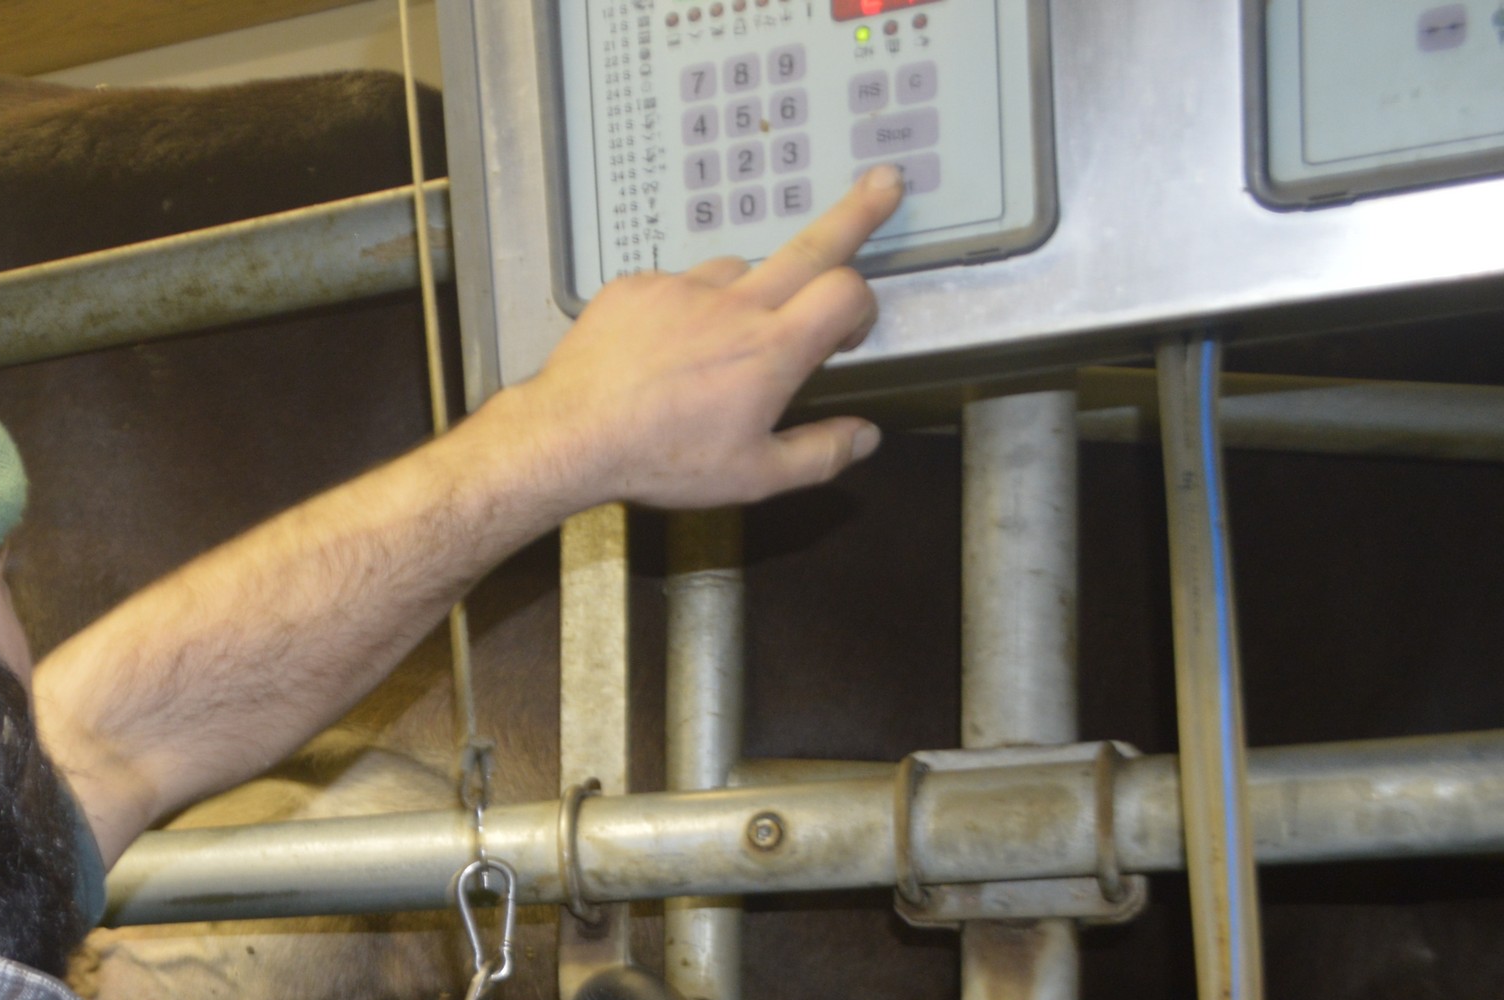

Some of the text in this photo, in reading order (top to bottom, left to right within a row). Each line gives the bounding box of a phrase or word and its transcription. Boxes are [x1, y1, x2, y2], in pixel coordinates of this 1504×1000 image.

[604, 56, 618, 68] 22
[690, 53, 794, 95] 7 8 9
[606, 88, 620, 100] 24
[692, 96, 796, 136] 4 5 6
[695, 141, 798, 181] 1 2 3
[613, 202, 627, 214] 40
[695, 201, 713, 225] S
[783, 185, 802, 209] E
[615, 236, 628, 248] 42
